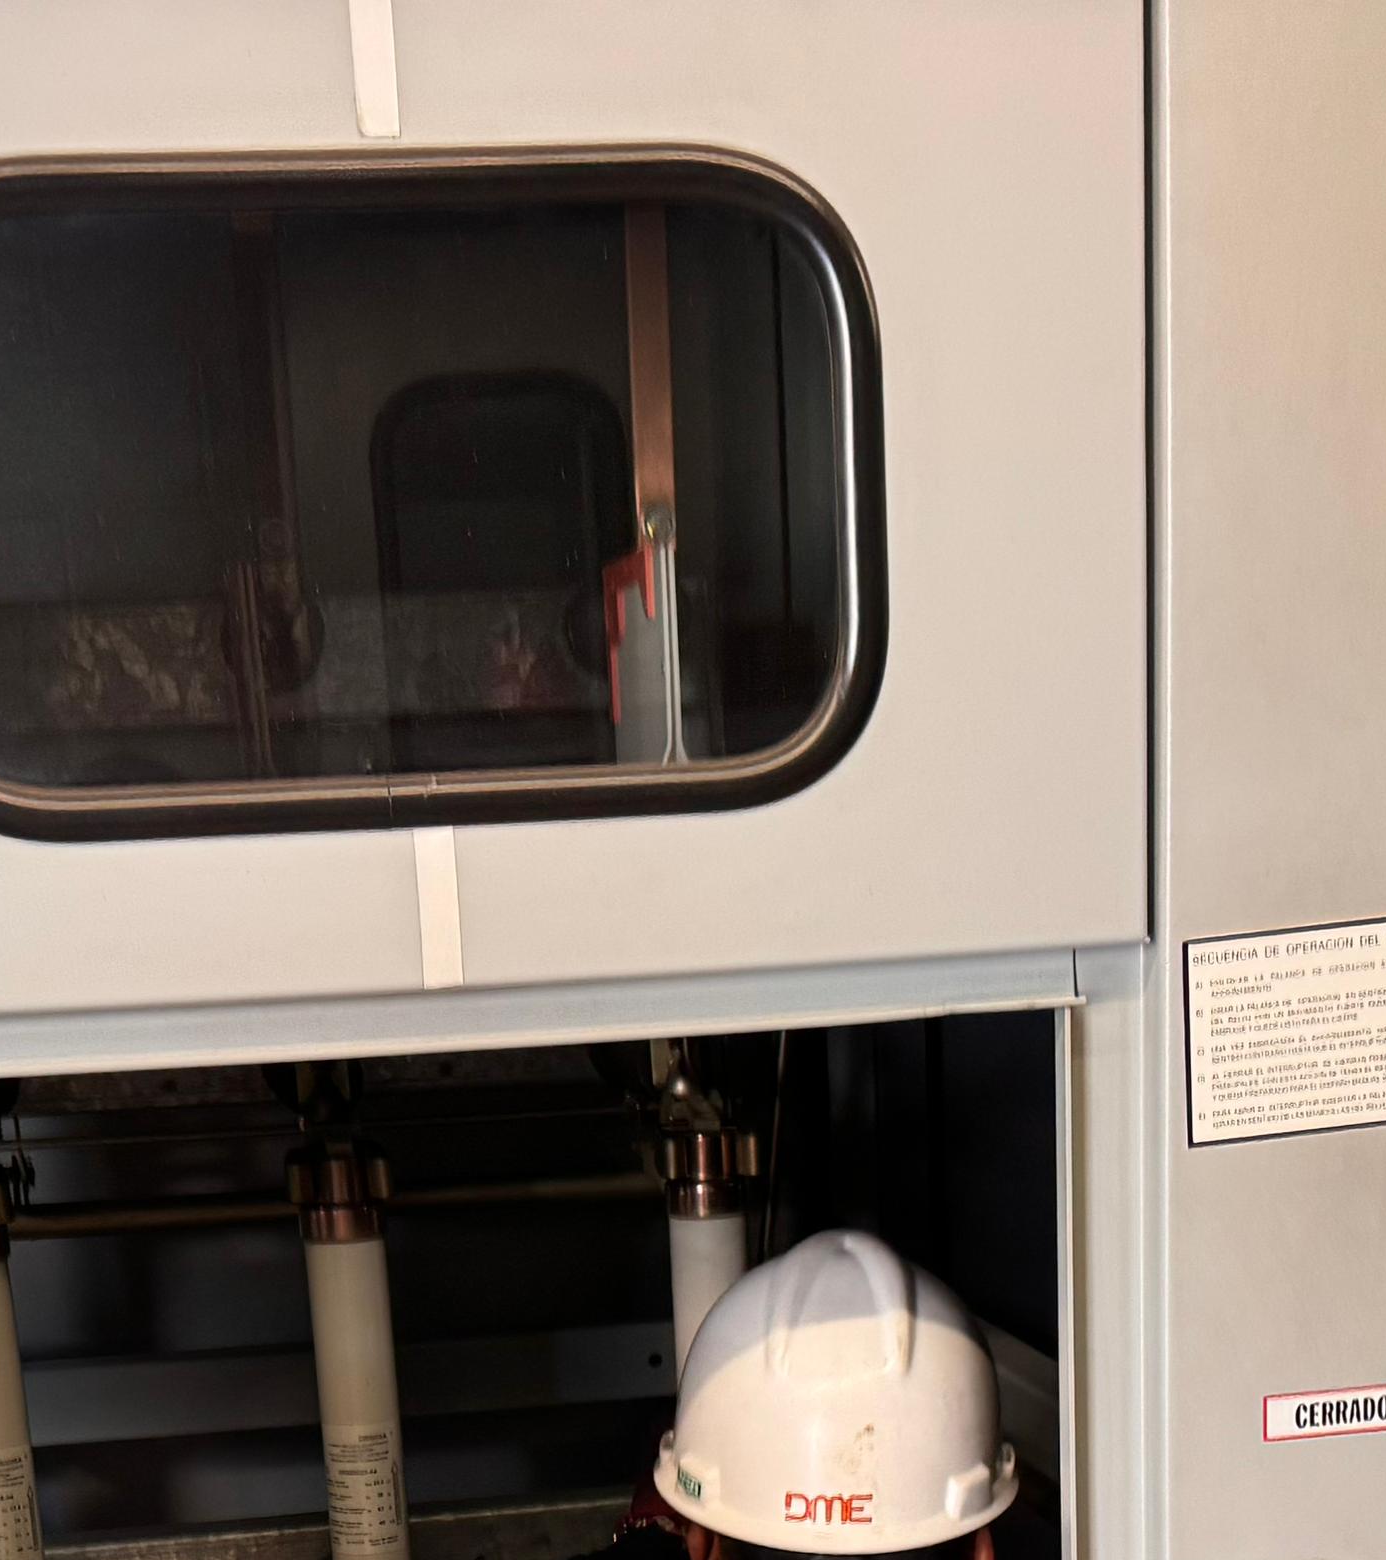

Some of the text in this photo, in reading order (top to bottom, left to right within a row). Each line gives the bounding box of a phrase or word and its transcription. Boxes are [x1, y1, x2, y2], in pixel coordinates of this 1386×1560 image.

[1264, 944, 1280, 959] DE
[1286, 937, 1353, 956] OPERACION
[1360, 933, 1381, 949] DEL
[784, 1490, 874, 1525] DME
